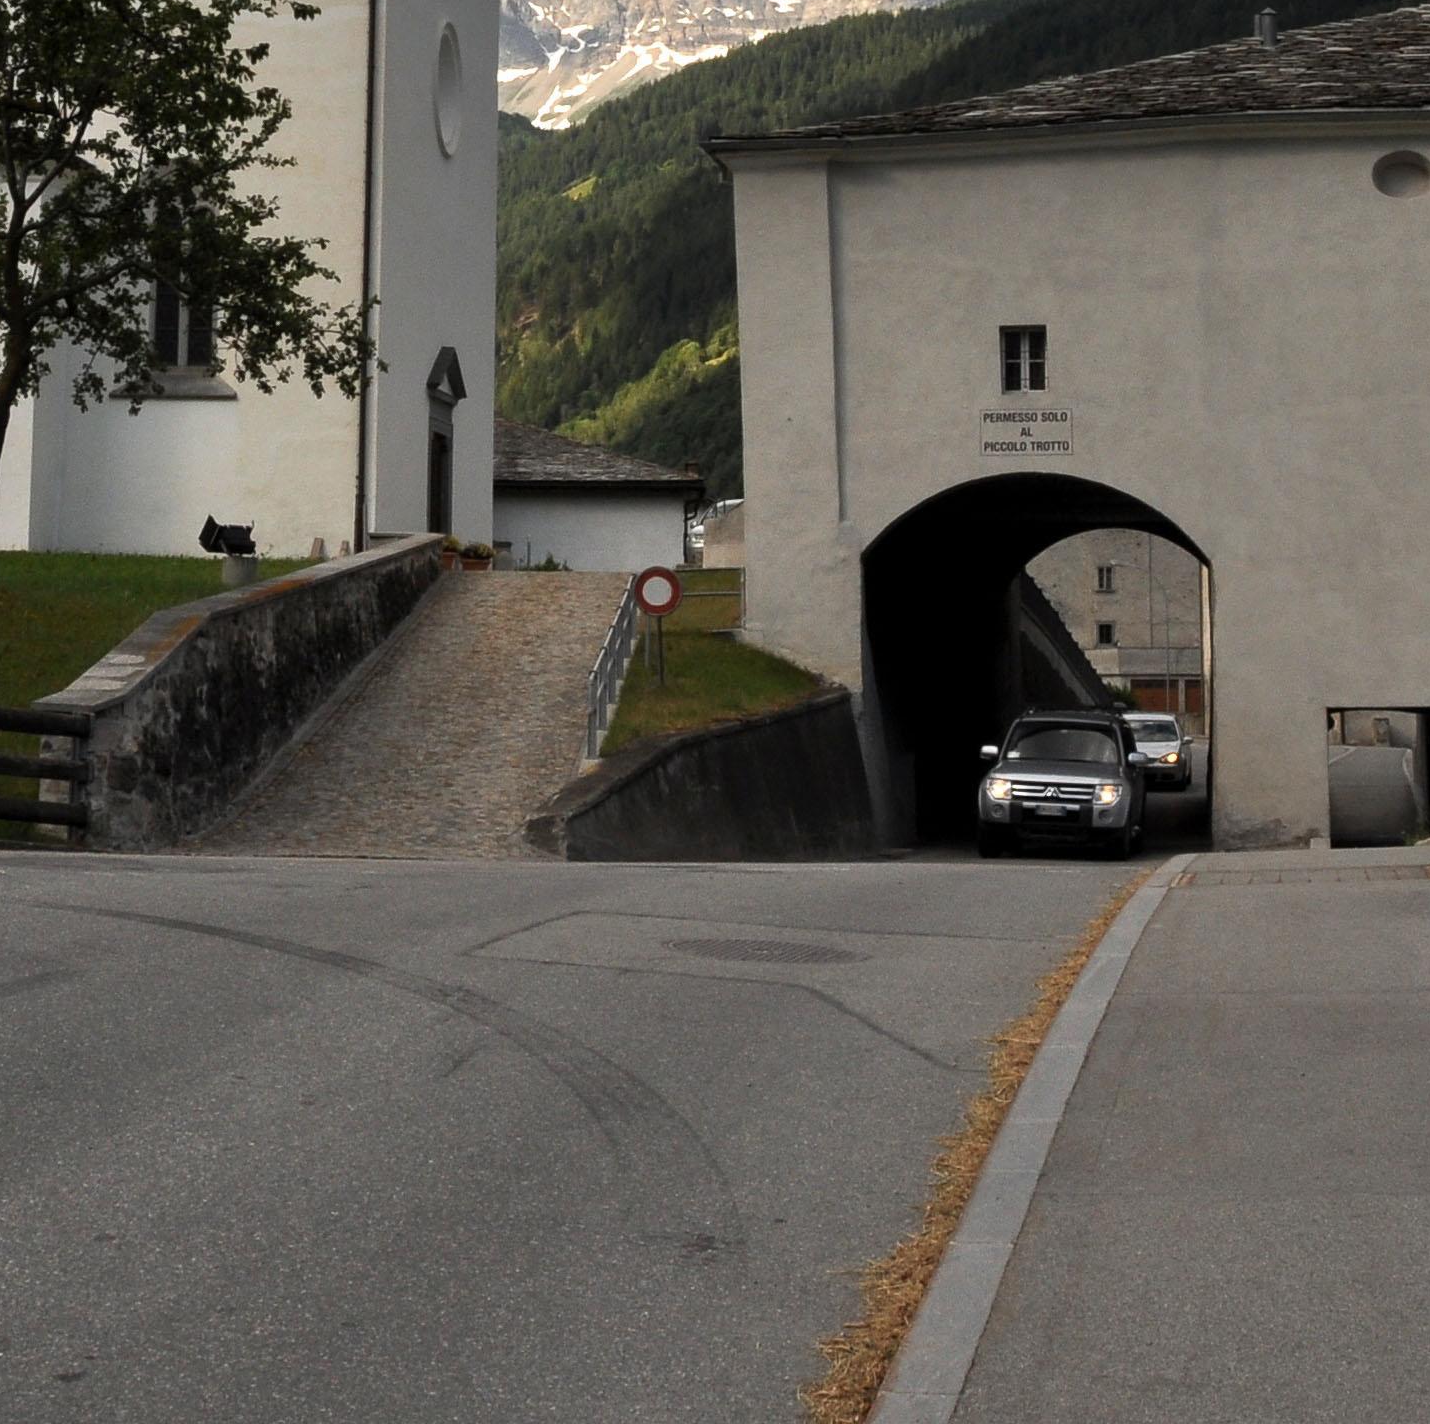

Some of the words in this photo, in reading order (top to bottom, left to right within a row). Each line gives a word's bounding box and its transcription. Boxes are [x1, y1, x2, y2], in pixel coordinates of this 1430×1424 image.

[983, 412, 1038, 423] PERMESSO
[1041, 412, 1068, 422] SOLO
[1020, 427, 1033, 437] AL
[983, 441, 1027, 452] PICCOLO
[1030, 441, 1070, 451] TROTTO
